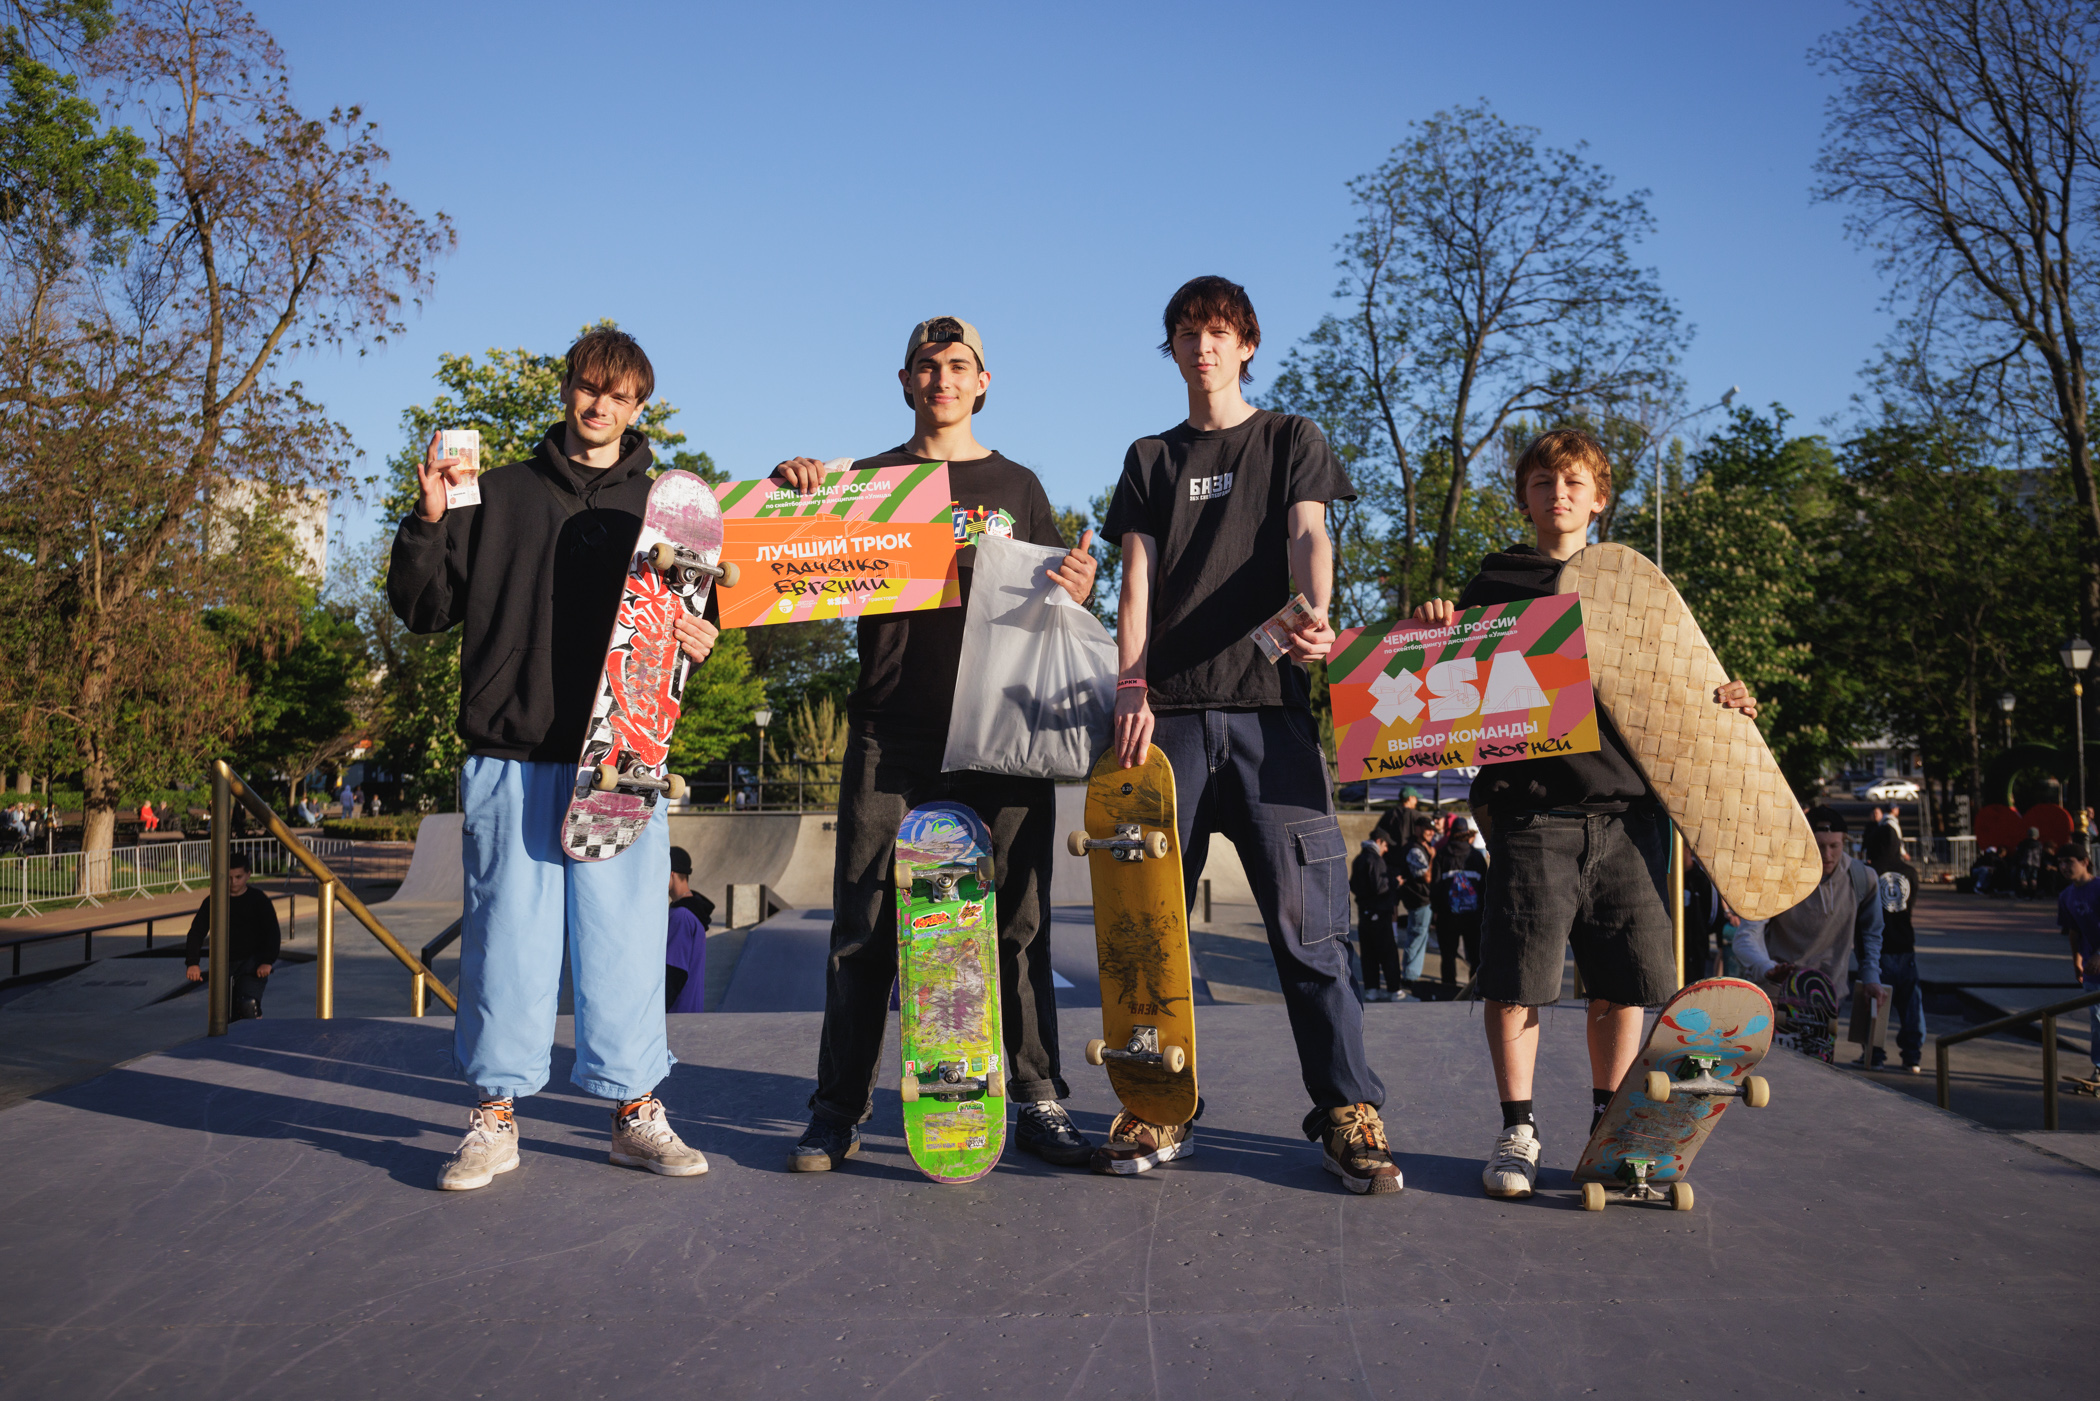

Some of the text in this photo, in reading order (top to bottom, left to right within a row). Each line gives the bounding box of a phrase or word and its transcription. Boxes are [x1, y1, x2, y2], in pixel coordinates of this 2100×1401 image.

[765, 480, 891, 501] ЧЕМПНАТ РОССИИ
[1190, 472, 1233, 495] БАЗА
[774, 500, 821, 508] скейтбордингу
[826, 495, 864, 503] дисциплине
[755, 532, 912, 562] ЛУЧШИЙ ТРЮК
[1383, 616, 1517, 645] ЧЕМПИОНАТ РОССИИ
[1393, 642, 1442, 653] скейтбордингу
[1447, 633, 1488, 646] дисциплине
[1488, 629, 1518, 639] «Улица»
[1387, 720, 1539, 753] ВЫБОР КОМАНДЫ
[1130, 1003, 1159, 1016] БАЗА
